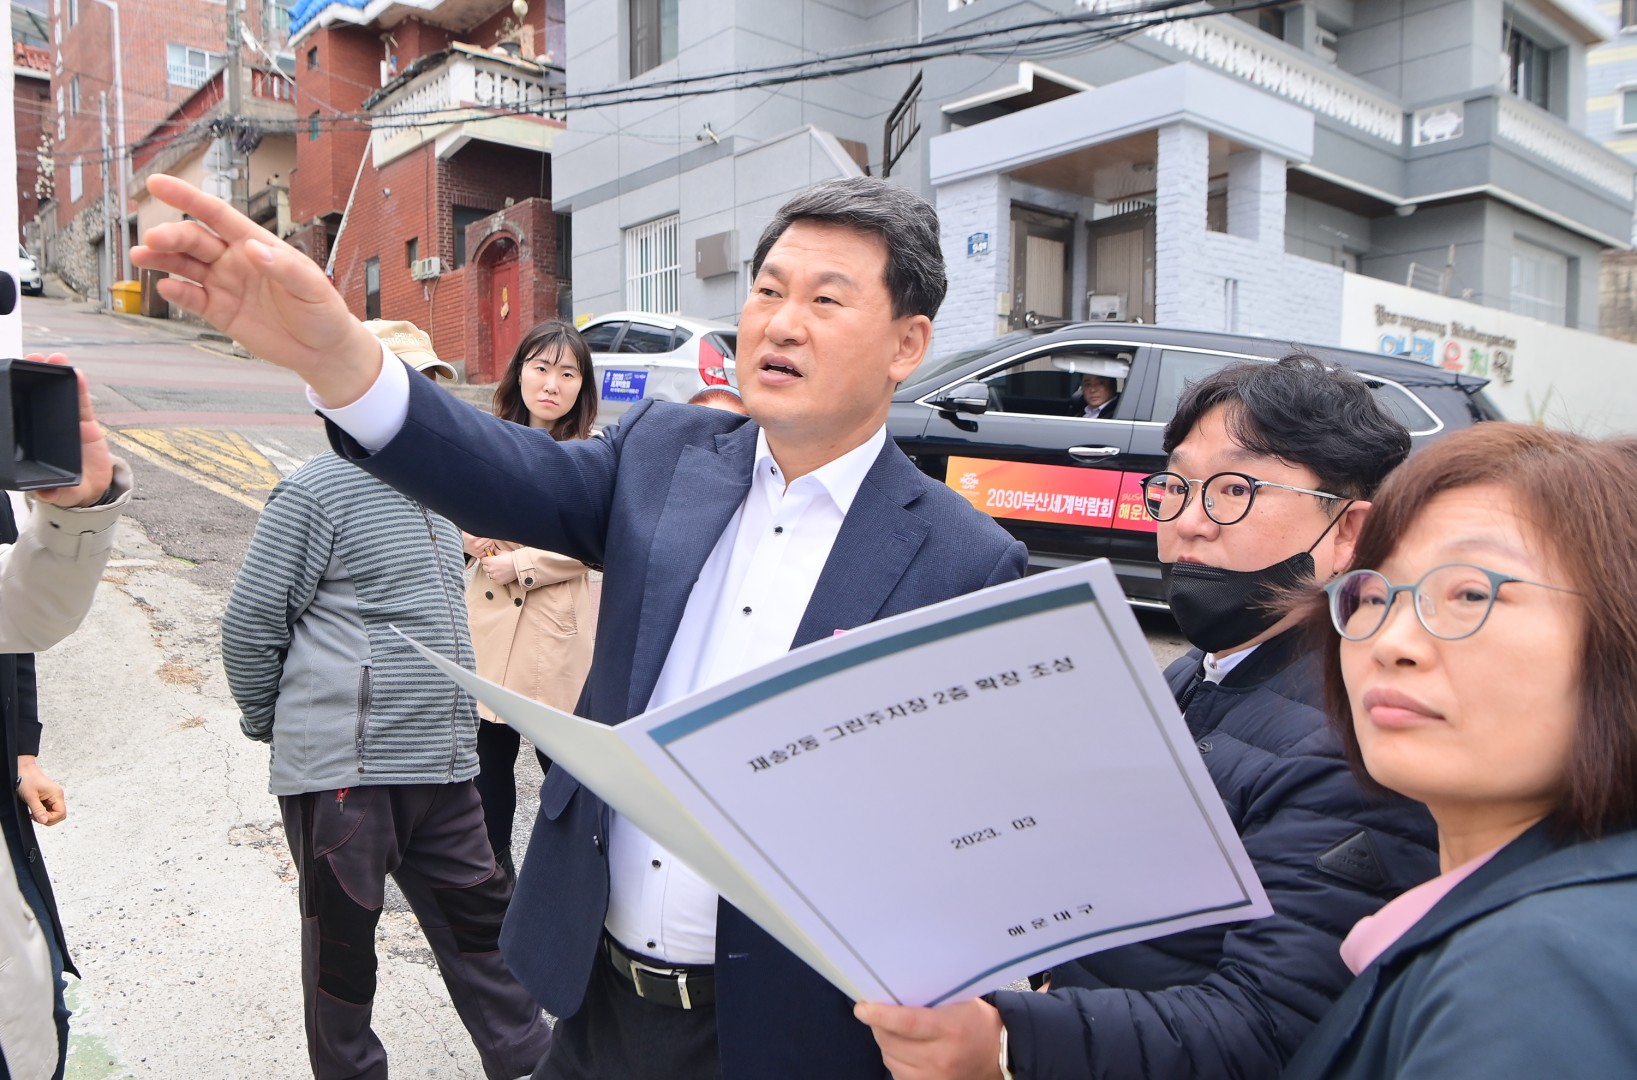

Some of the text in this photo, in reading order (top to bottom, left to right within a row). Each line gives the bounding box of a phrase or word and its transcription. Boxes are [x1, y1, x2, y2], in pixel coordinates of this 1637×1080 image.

[986, 488, 1114, 518] 2030부산세계박람회
[748, 656, 1075, 772] 재송2동 그린주차장 2층 확장 조성
[951, 816, 1037, 850] 2023. 03
